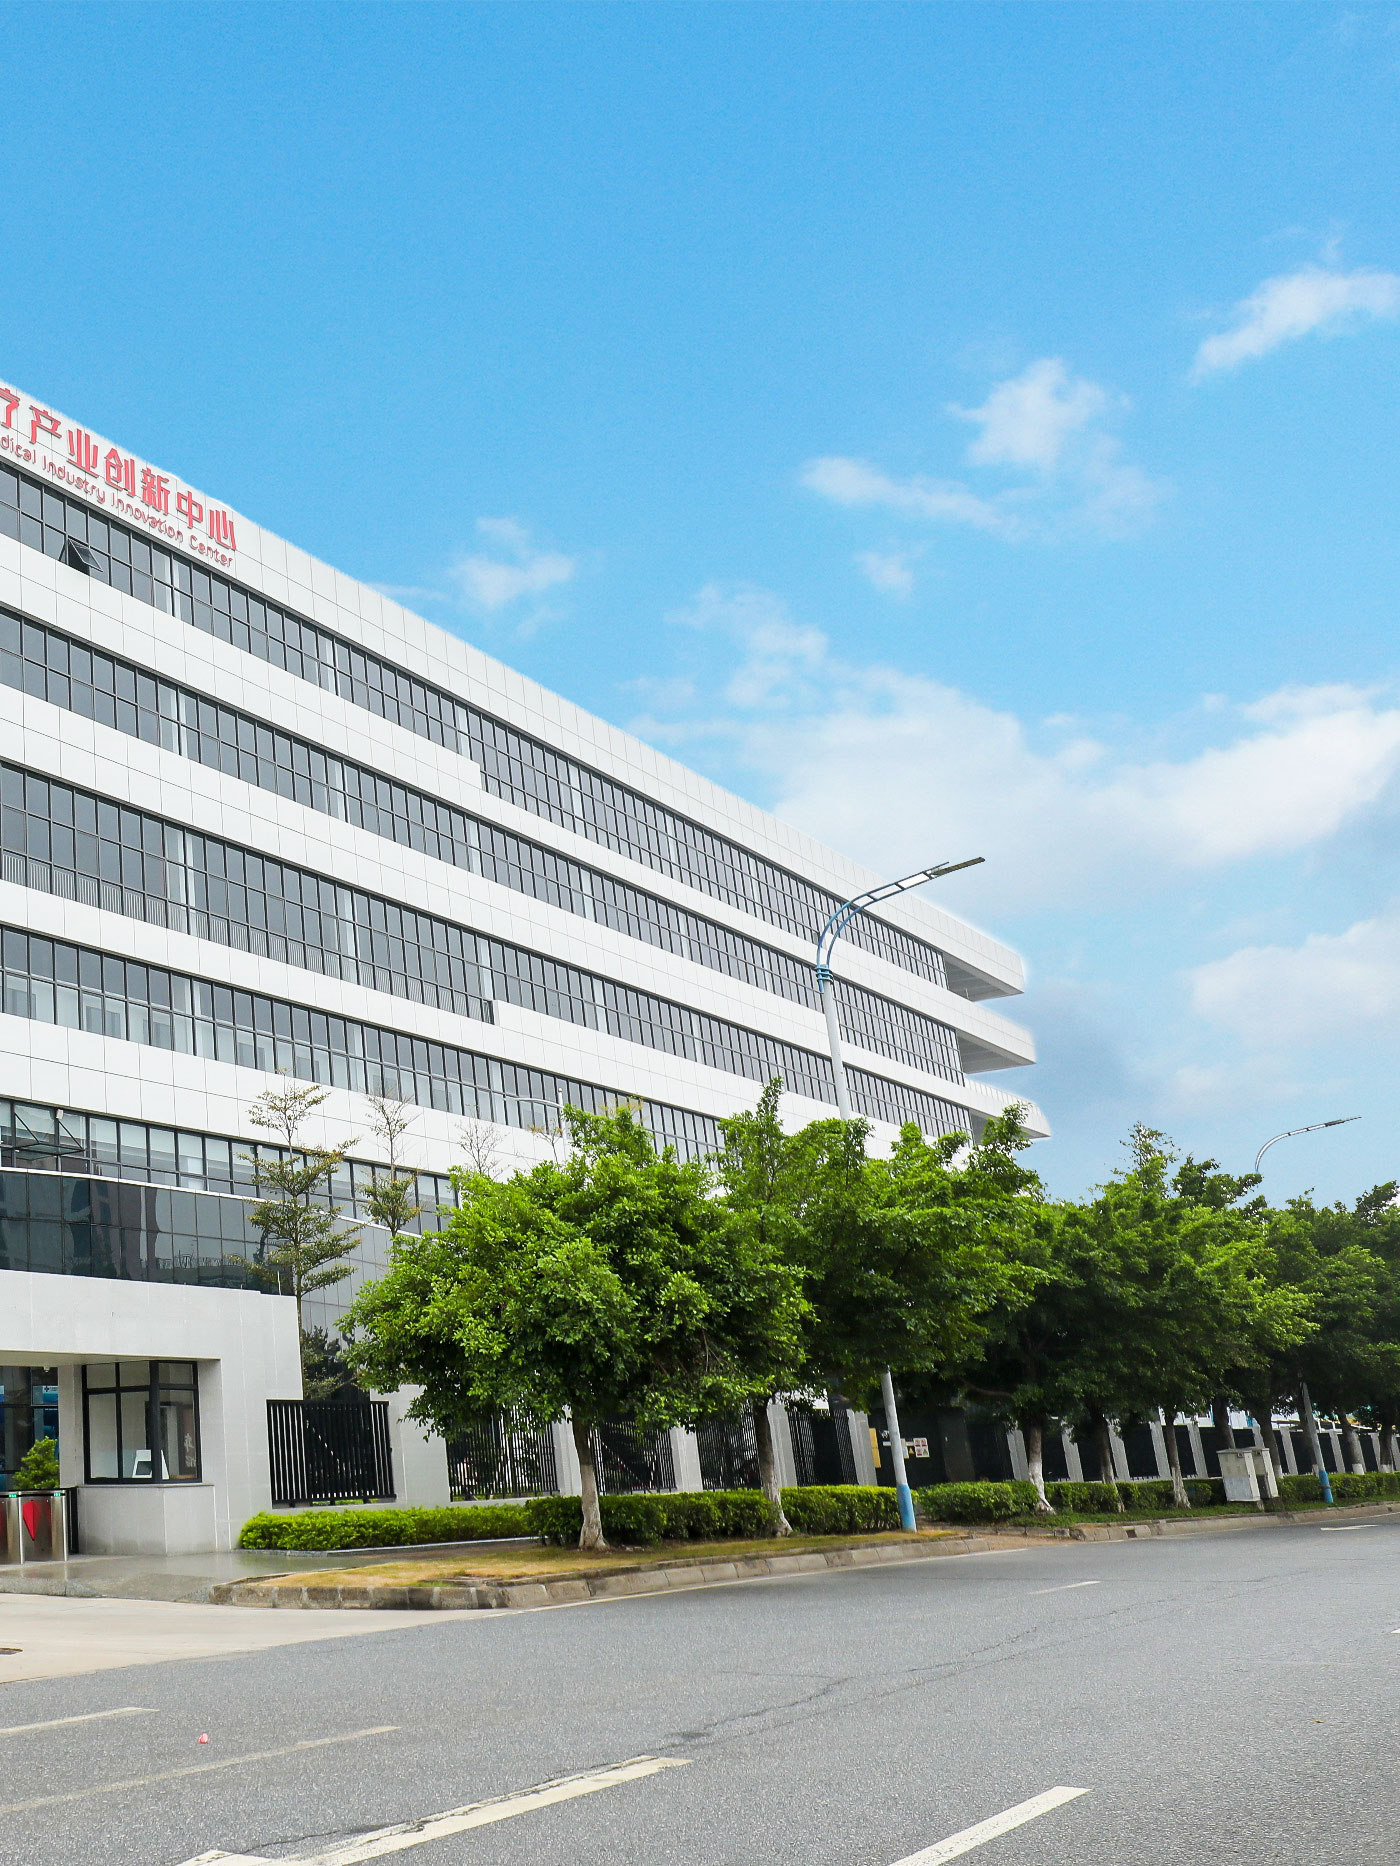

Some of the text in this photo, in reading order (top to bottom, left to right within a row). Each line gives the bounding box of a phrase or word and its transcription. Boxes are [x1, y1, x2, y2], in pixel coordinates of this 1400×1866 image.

[42, 455, 106, 504] Industry
[111, 492, 184, 544] Innovation
[188, 534, 234, 568] Center
